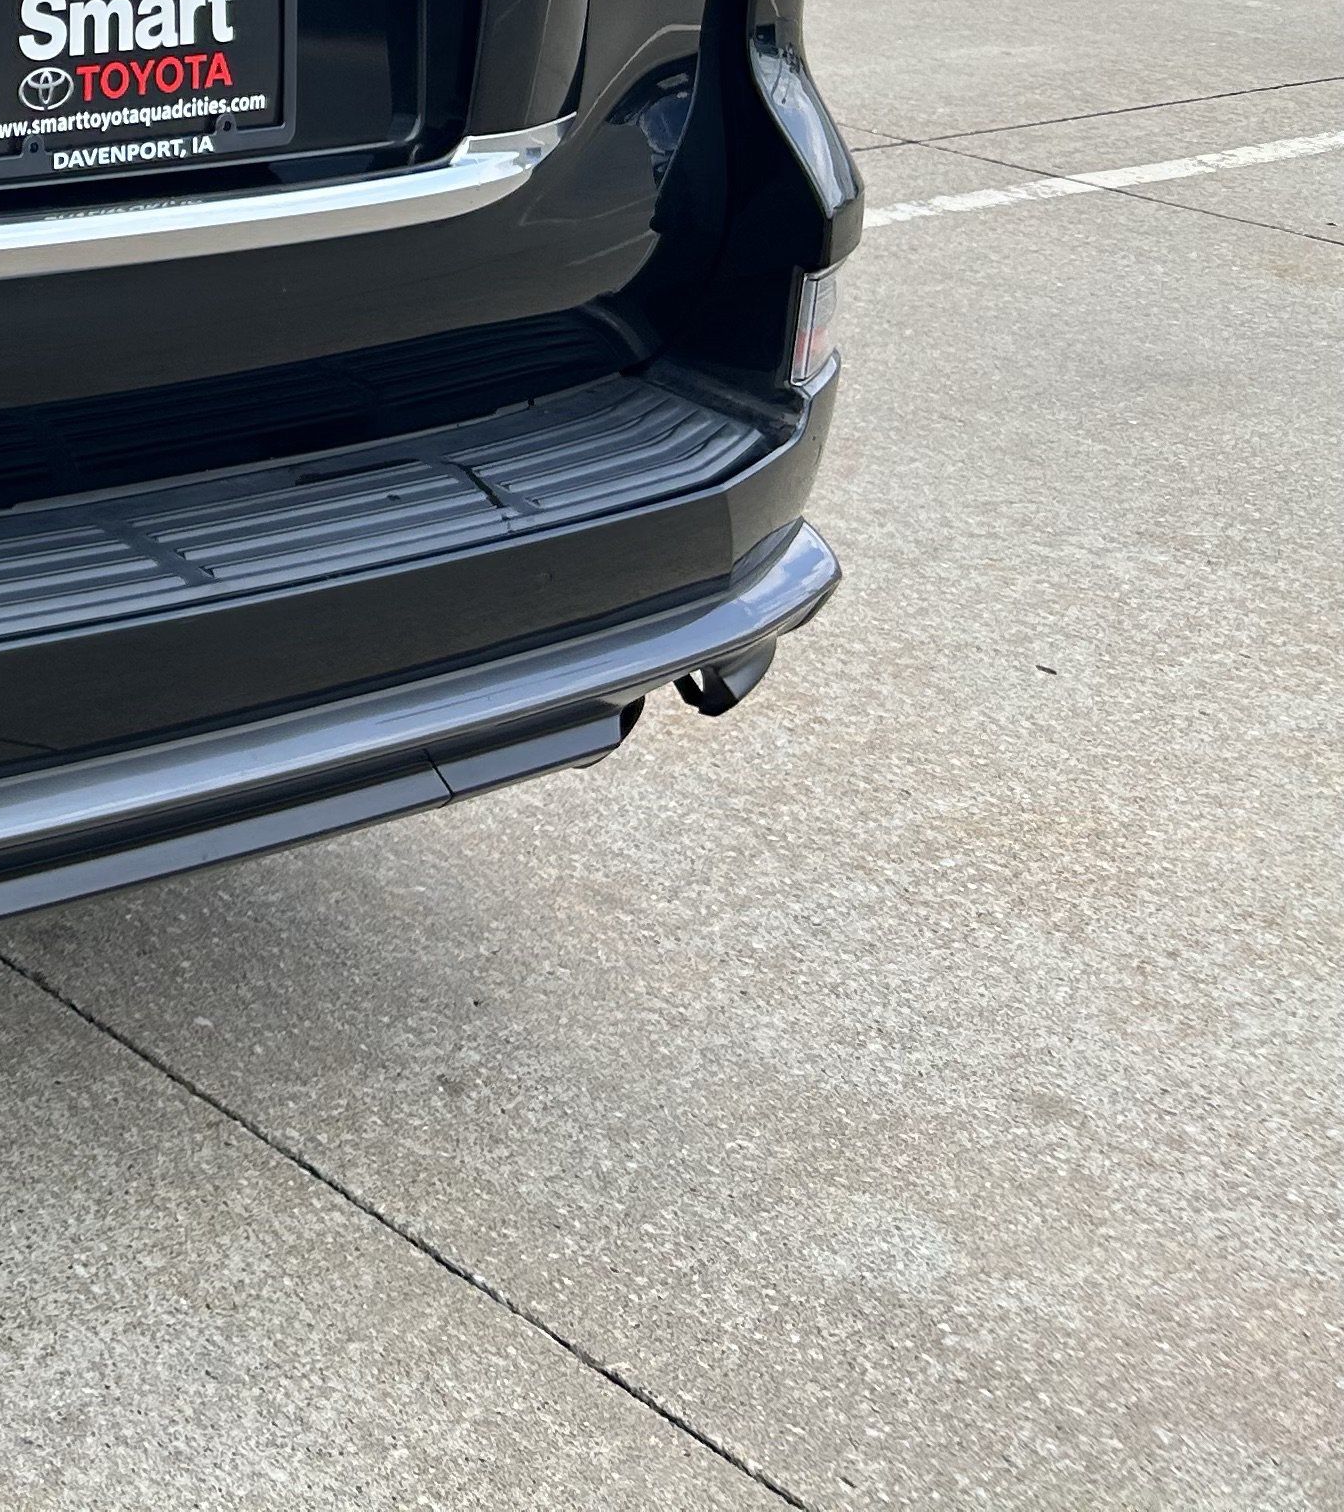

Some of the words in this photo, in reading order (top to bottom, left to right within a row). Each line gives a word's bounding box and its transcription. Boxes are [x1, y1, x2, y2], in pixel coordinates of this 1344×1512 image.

[75, 51, 233, 102] TOYOTA
[52, 138, 187, 170] DAVENPORT,
[192, 135, 214, 154] IA
